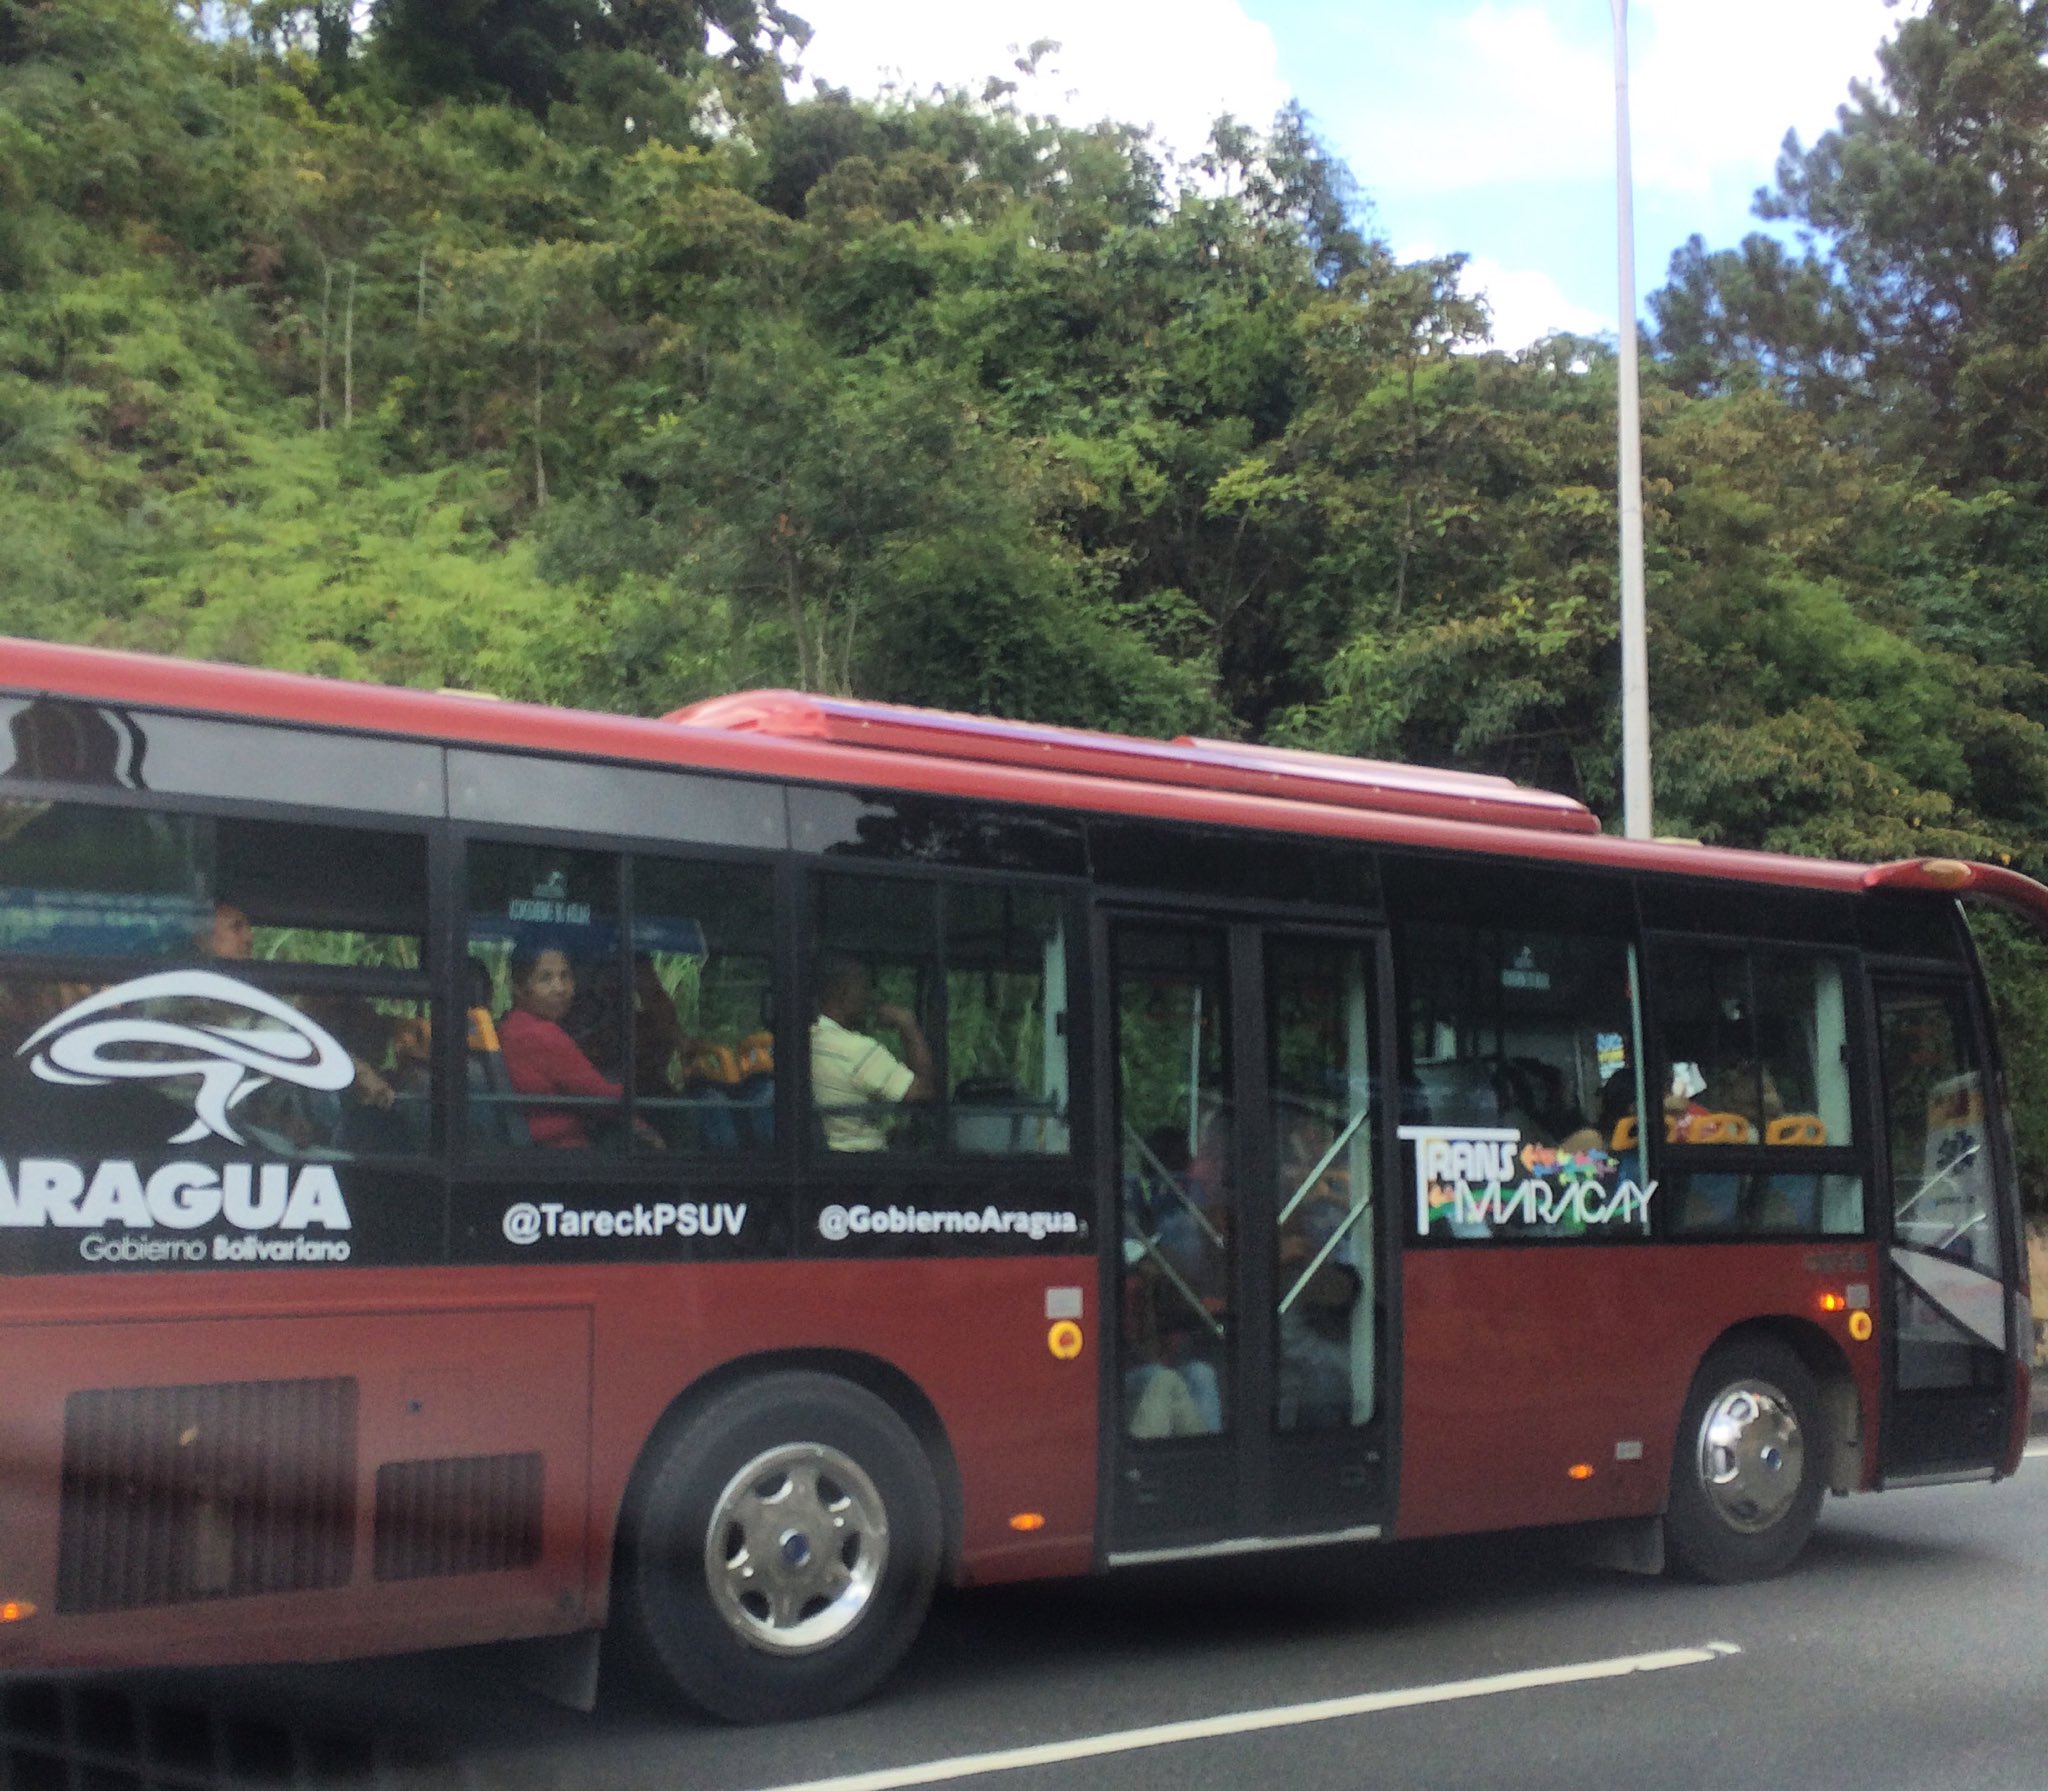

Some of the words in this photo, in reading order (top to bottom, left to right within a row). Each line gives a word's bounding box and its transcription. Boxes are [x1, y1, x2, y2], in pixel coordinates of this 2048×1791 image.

[1397, 1125, 1521, 1236] TRANS
[1454, 1178, 1659, 1224] MARACAY
[502, 1202, 747, 1245] @TareckPSUV
[818, 1204, 1079, 1241] @GobiernoAragua
[79, 1234, 207, 1262] Gobierno
[213, 1234, 351, 1262] Bolivariano
